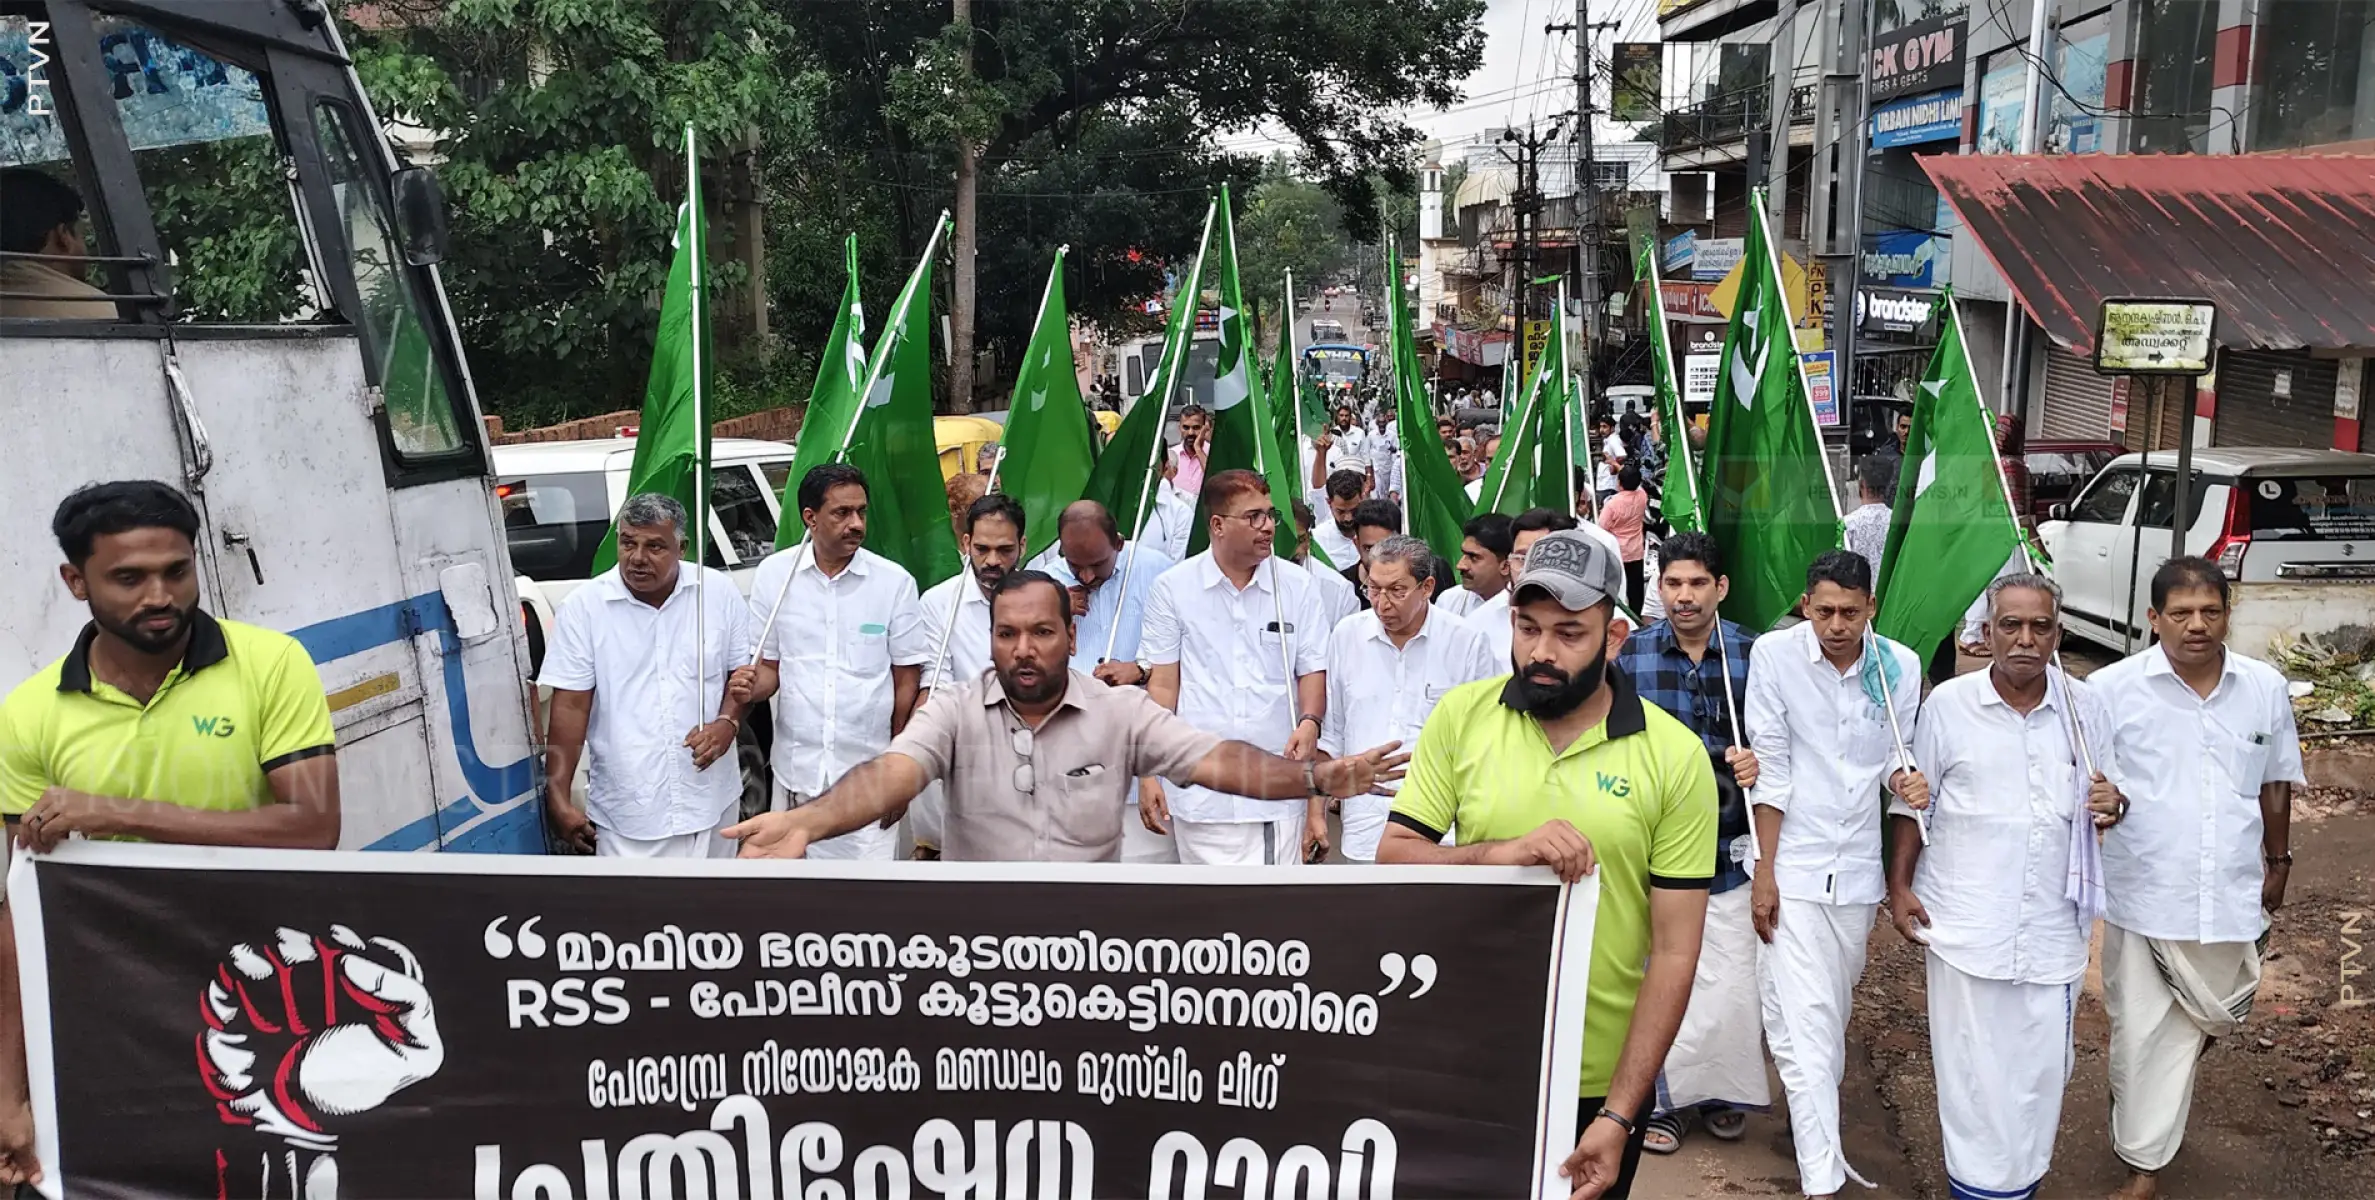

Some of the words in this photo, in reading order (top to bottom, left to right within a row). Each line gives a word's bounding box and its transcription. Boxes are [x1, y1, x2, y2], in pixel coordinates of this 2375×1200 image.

[1872, 42, 1899, 80] CK
[1903, 28, 1955, 70] GYM
[1871, 79, 1890, 94] DIES
[1877, 106, 1911, 133] URBAN
[1911, 100, 1939, 128] NIDHI
[1940, 95, 1962, 124] LIMI
[1869, 291, 1932, 322] brandster
[2264, 483, 2277, 495] L
[759, 929, 1311, 978] ഭരണകൂടത്തിനെതിരെ
[506, 978, 631, 1029] RSS
[690, 973, 908, 1018] പോലീസ്
[588, 1054, 727, 1112] പേരാമ്പ്ര
[743, 1040, 921, 1096] നിയോജക
[935, 1047, 1063, 1093] മണ്ഡലം
[1217, 1050, 1287, 1111] ലീഗ്
